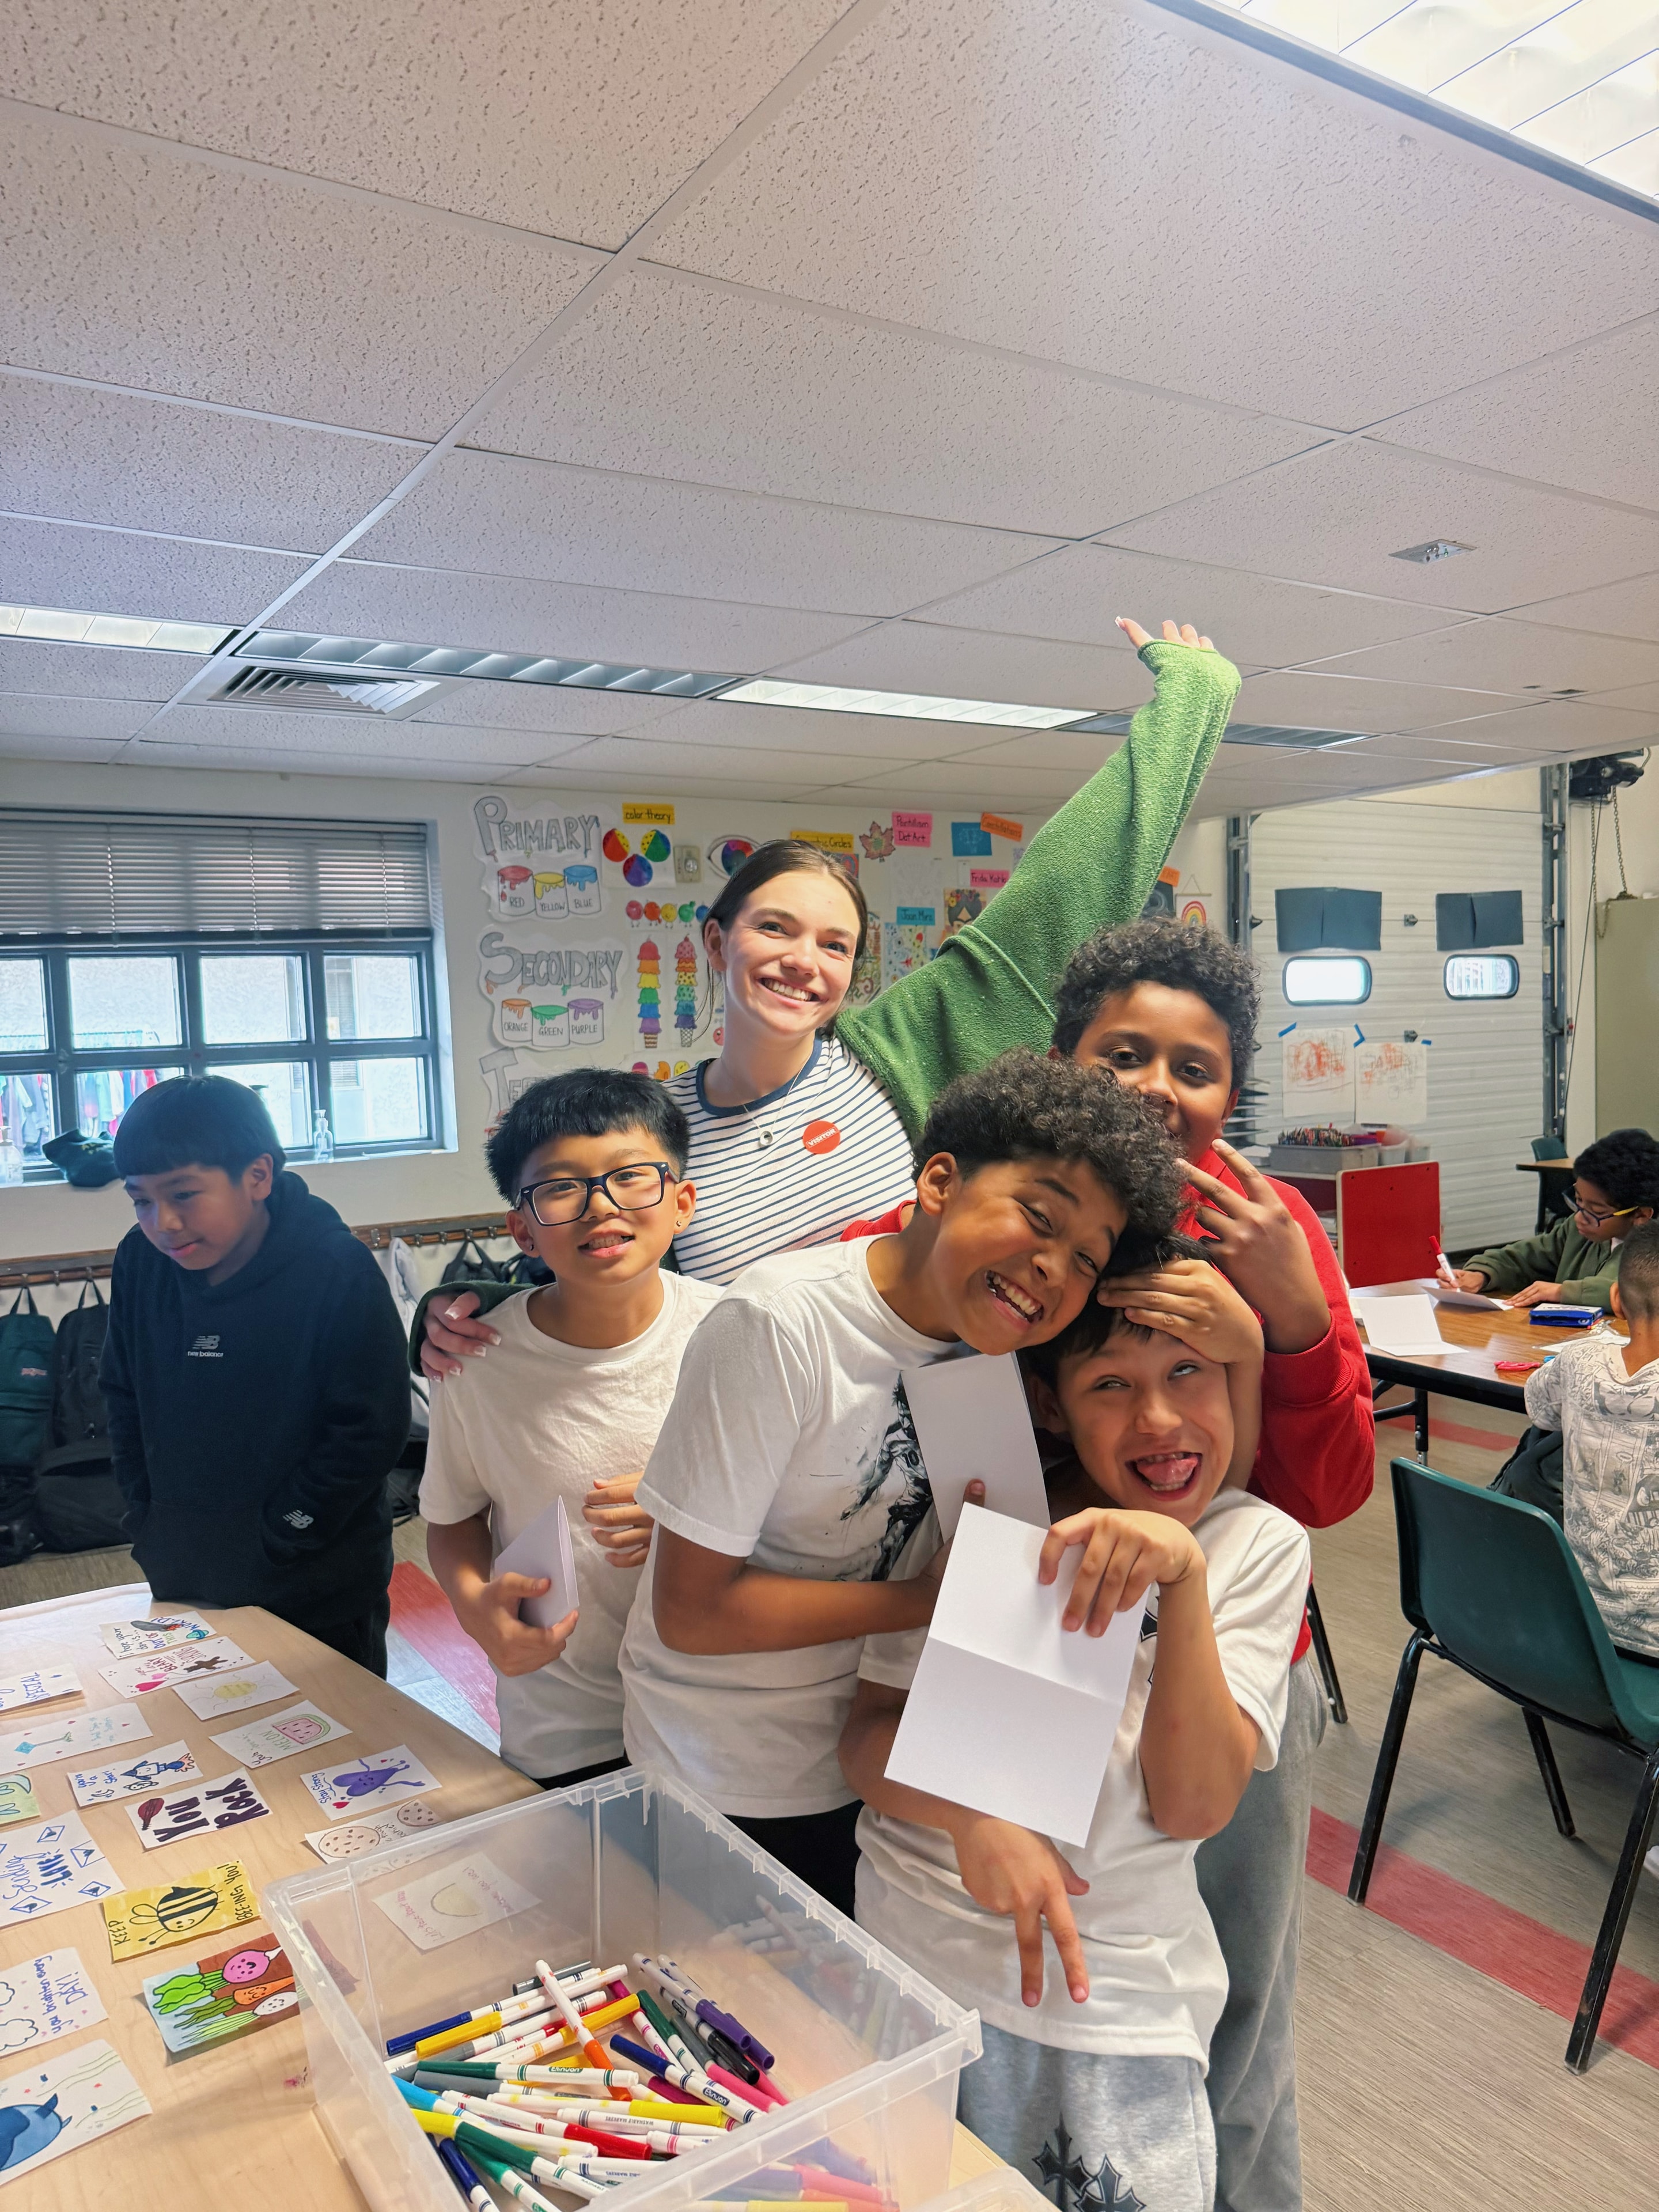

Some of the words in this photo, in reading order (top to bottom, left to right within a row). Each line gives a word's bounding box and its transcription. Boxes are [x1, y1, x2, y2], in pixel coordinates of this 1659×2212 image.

[626, 808, 643, 819] color
[645, 808, 671, 824] theory
[474, 796, 599, 856] PRIMARY
[509, 897, 525, 907] RED
[540, 903, 566, 912] YELLOW
[574, 899, 593, 909] BLUE
[480, 932, 623, 989] SECONDARY
[503, 1022, 528, 1032] ORANGE
[539, 1027, 563, 1036] GREEN
[571, 1024, 598, 1035] PURPLE
[808, 1127, 836, 1146] VISITOR
[902, 1450, 920, 1468] 10
[149, 1637, 167, 1649] OUT
[161, 1631, 178, 1643] THIS
[146, 1657, 177, 1672] BEARY
[258, 1730, 296, 1751] MELON
[311, 1773, 325, 1789] Strong
[318, 1788, 332, 1804] Stay
[37, 1853, 72, 1886] LOVE
[217, 1861, 242, 1884] YOU!
[229, 1884, 253, 1921] BEE-ING
[108, 1919, 131, 1945] KEEP
[40, 1978, 64, 2014] brighten
[55, 1971, 88, 2005] DAY!
[48, 2016, 73, 2033] you
[704, 2088, 728, 2105] Elinuan
